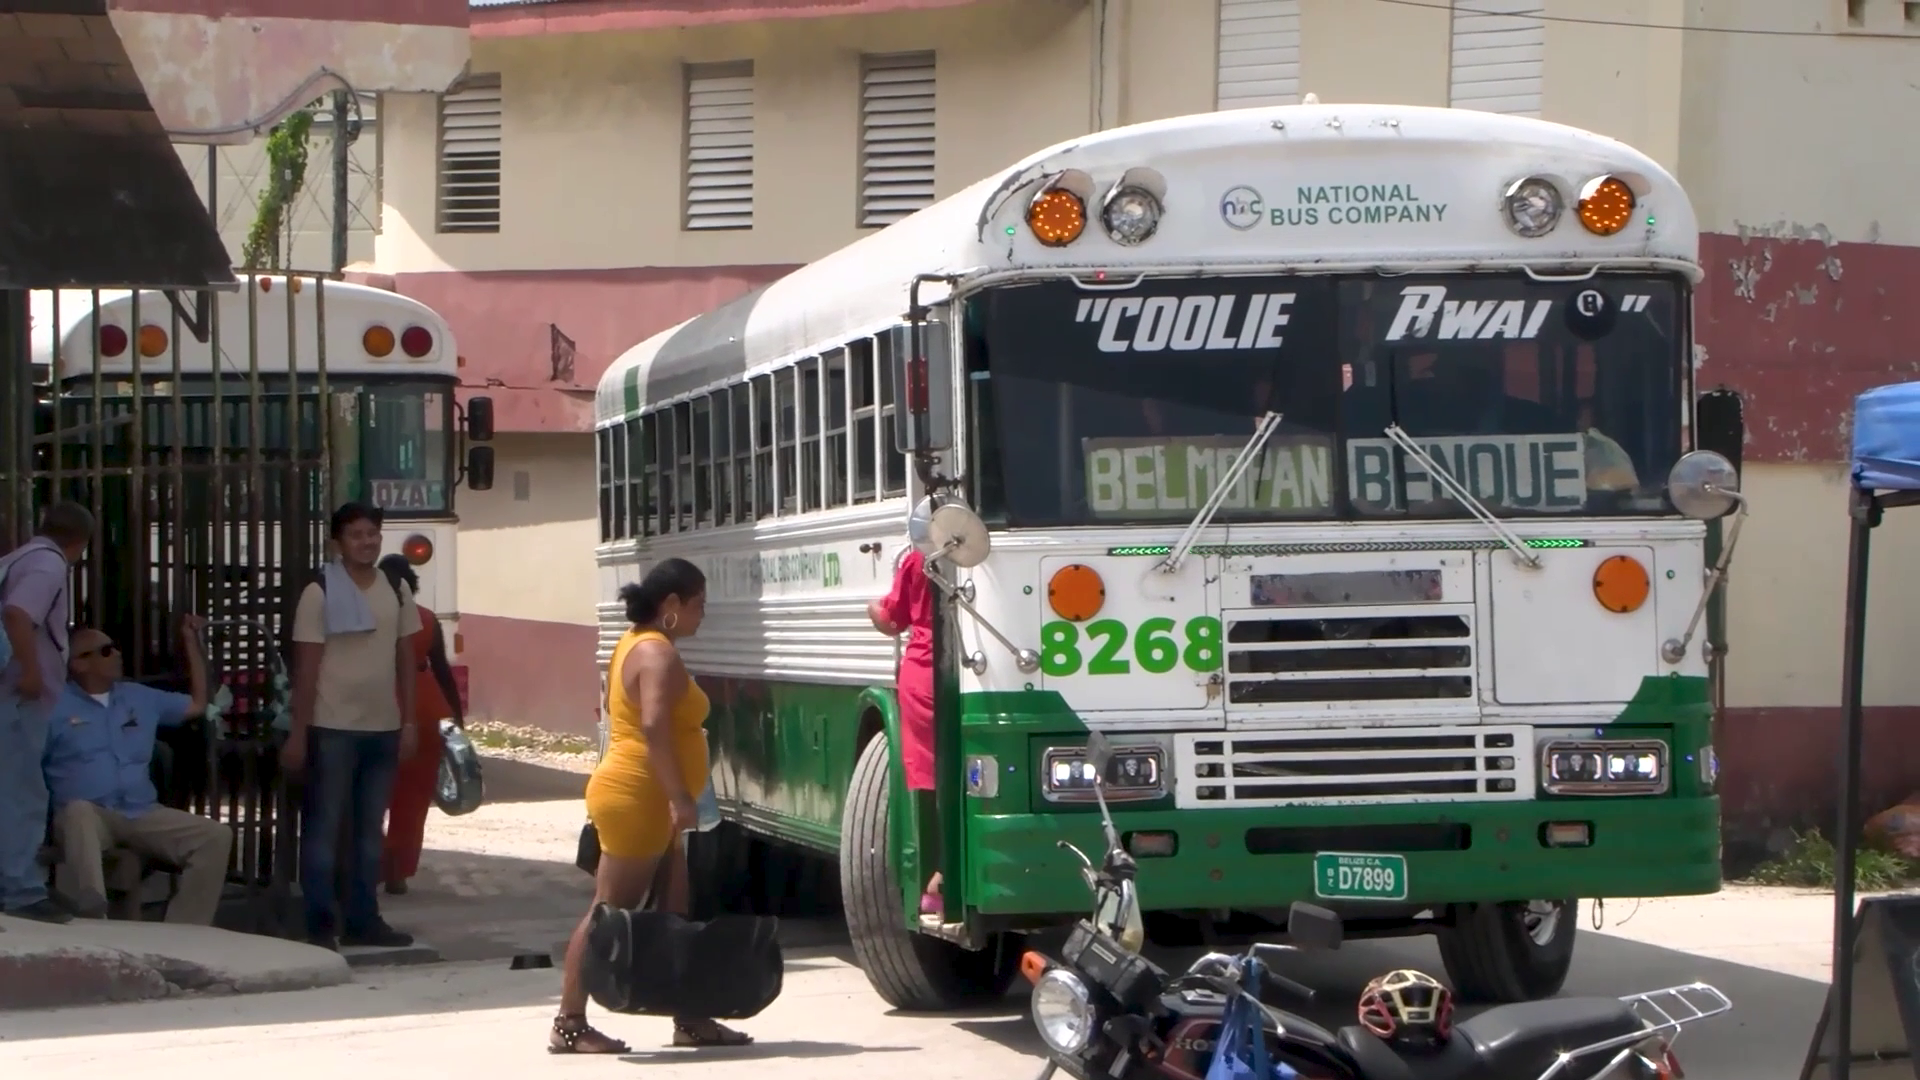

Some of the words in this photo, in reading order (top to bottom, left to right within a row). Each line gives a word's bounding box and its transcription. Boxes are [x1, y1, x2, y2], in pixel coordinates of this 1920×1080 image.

[1297, 184, 1419, 205] NATIONAL
[1270, 208, 1318, 226] BUS
[1328, 204, 1448, 224] COMPANY
[1091, 445, 1331, 511] BELMOPAN
[1041, 616, 1223, 677] 8268
[1338, 856, 1365, 866] BELIZE
[1339, 866, 1394, 892] D7899
